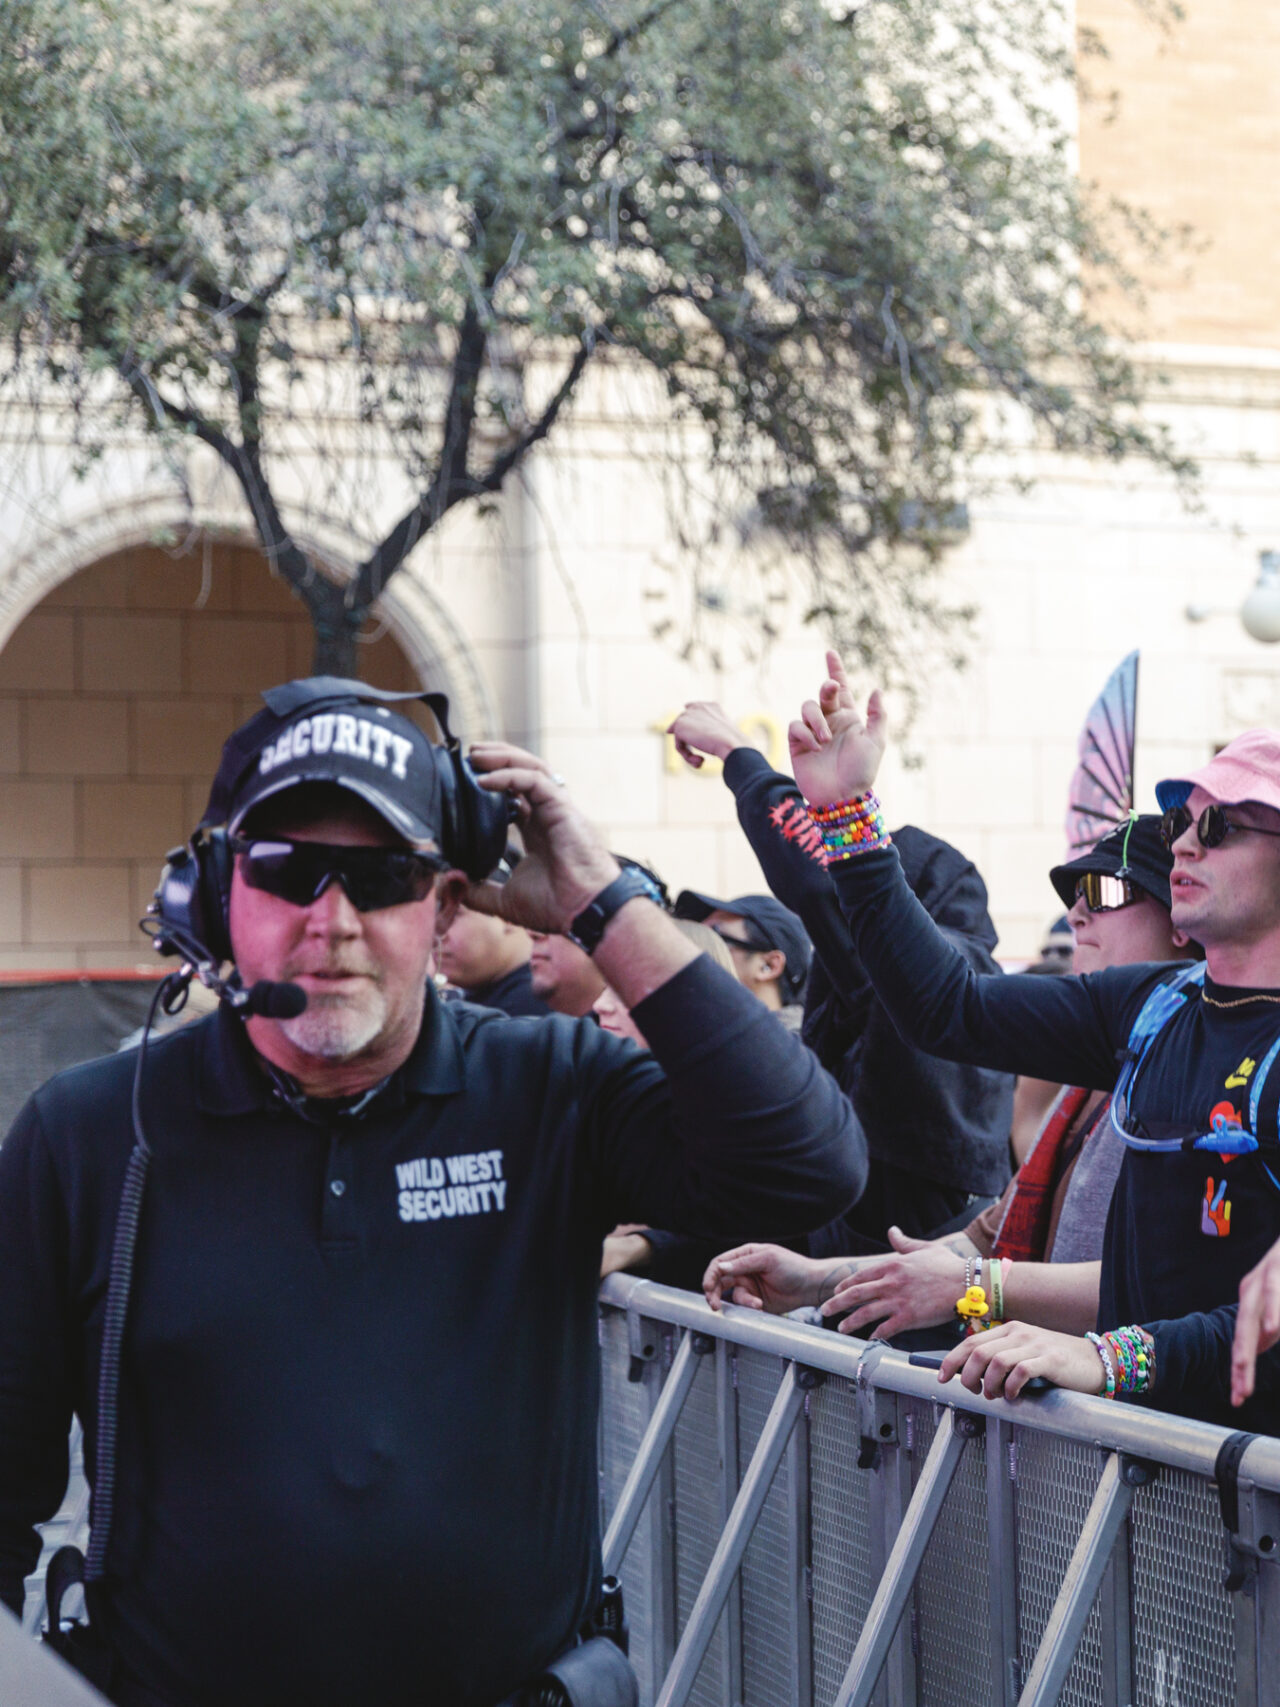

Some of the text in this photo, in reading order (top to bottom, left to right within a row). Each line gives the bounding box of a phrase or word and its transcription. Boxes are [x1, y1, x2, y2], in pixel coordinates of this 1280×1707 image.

[259, 713, 414, 780] SECURITY
[395, 1149, 502, 1190] WILD WEST
[397, 1180, 507, 1223] SECURITY
